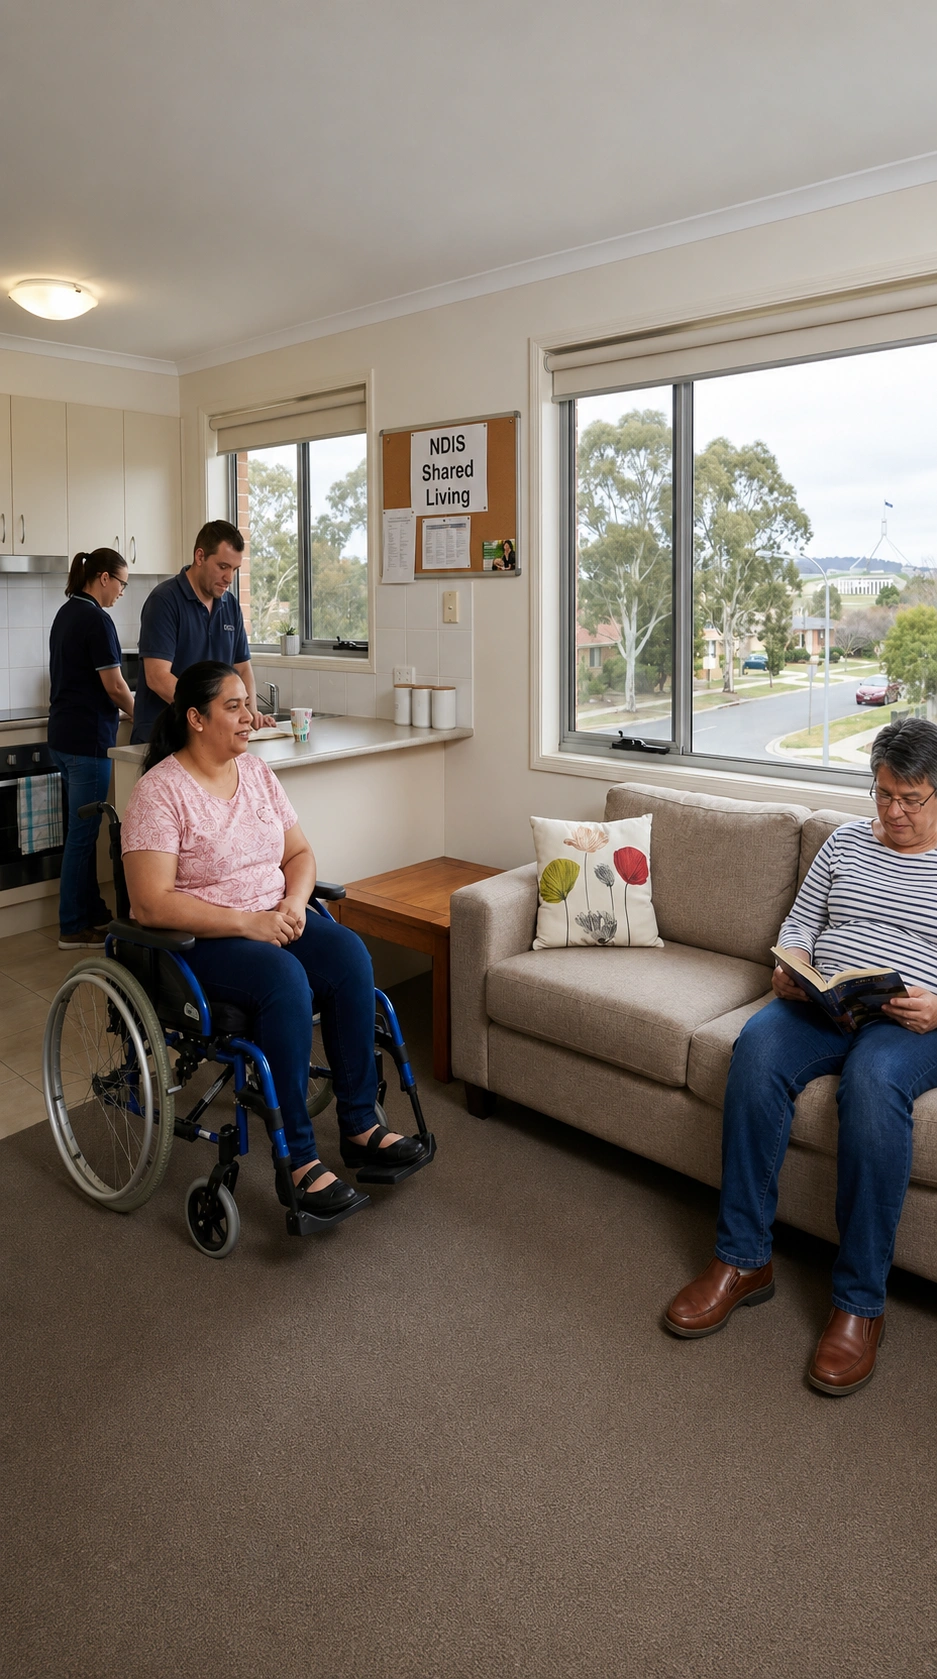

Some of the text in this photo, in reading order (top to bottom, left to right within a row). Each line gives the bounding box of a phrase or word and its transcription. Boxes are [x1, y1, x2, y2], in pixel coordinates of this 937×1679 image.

[430, 434, 466, 455] NDIS
[422, 459, 474, 481] Shared
[426, 487, 470, 508] Living
